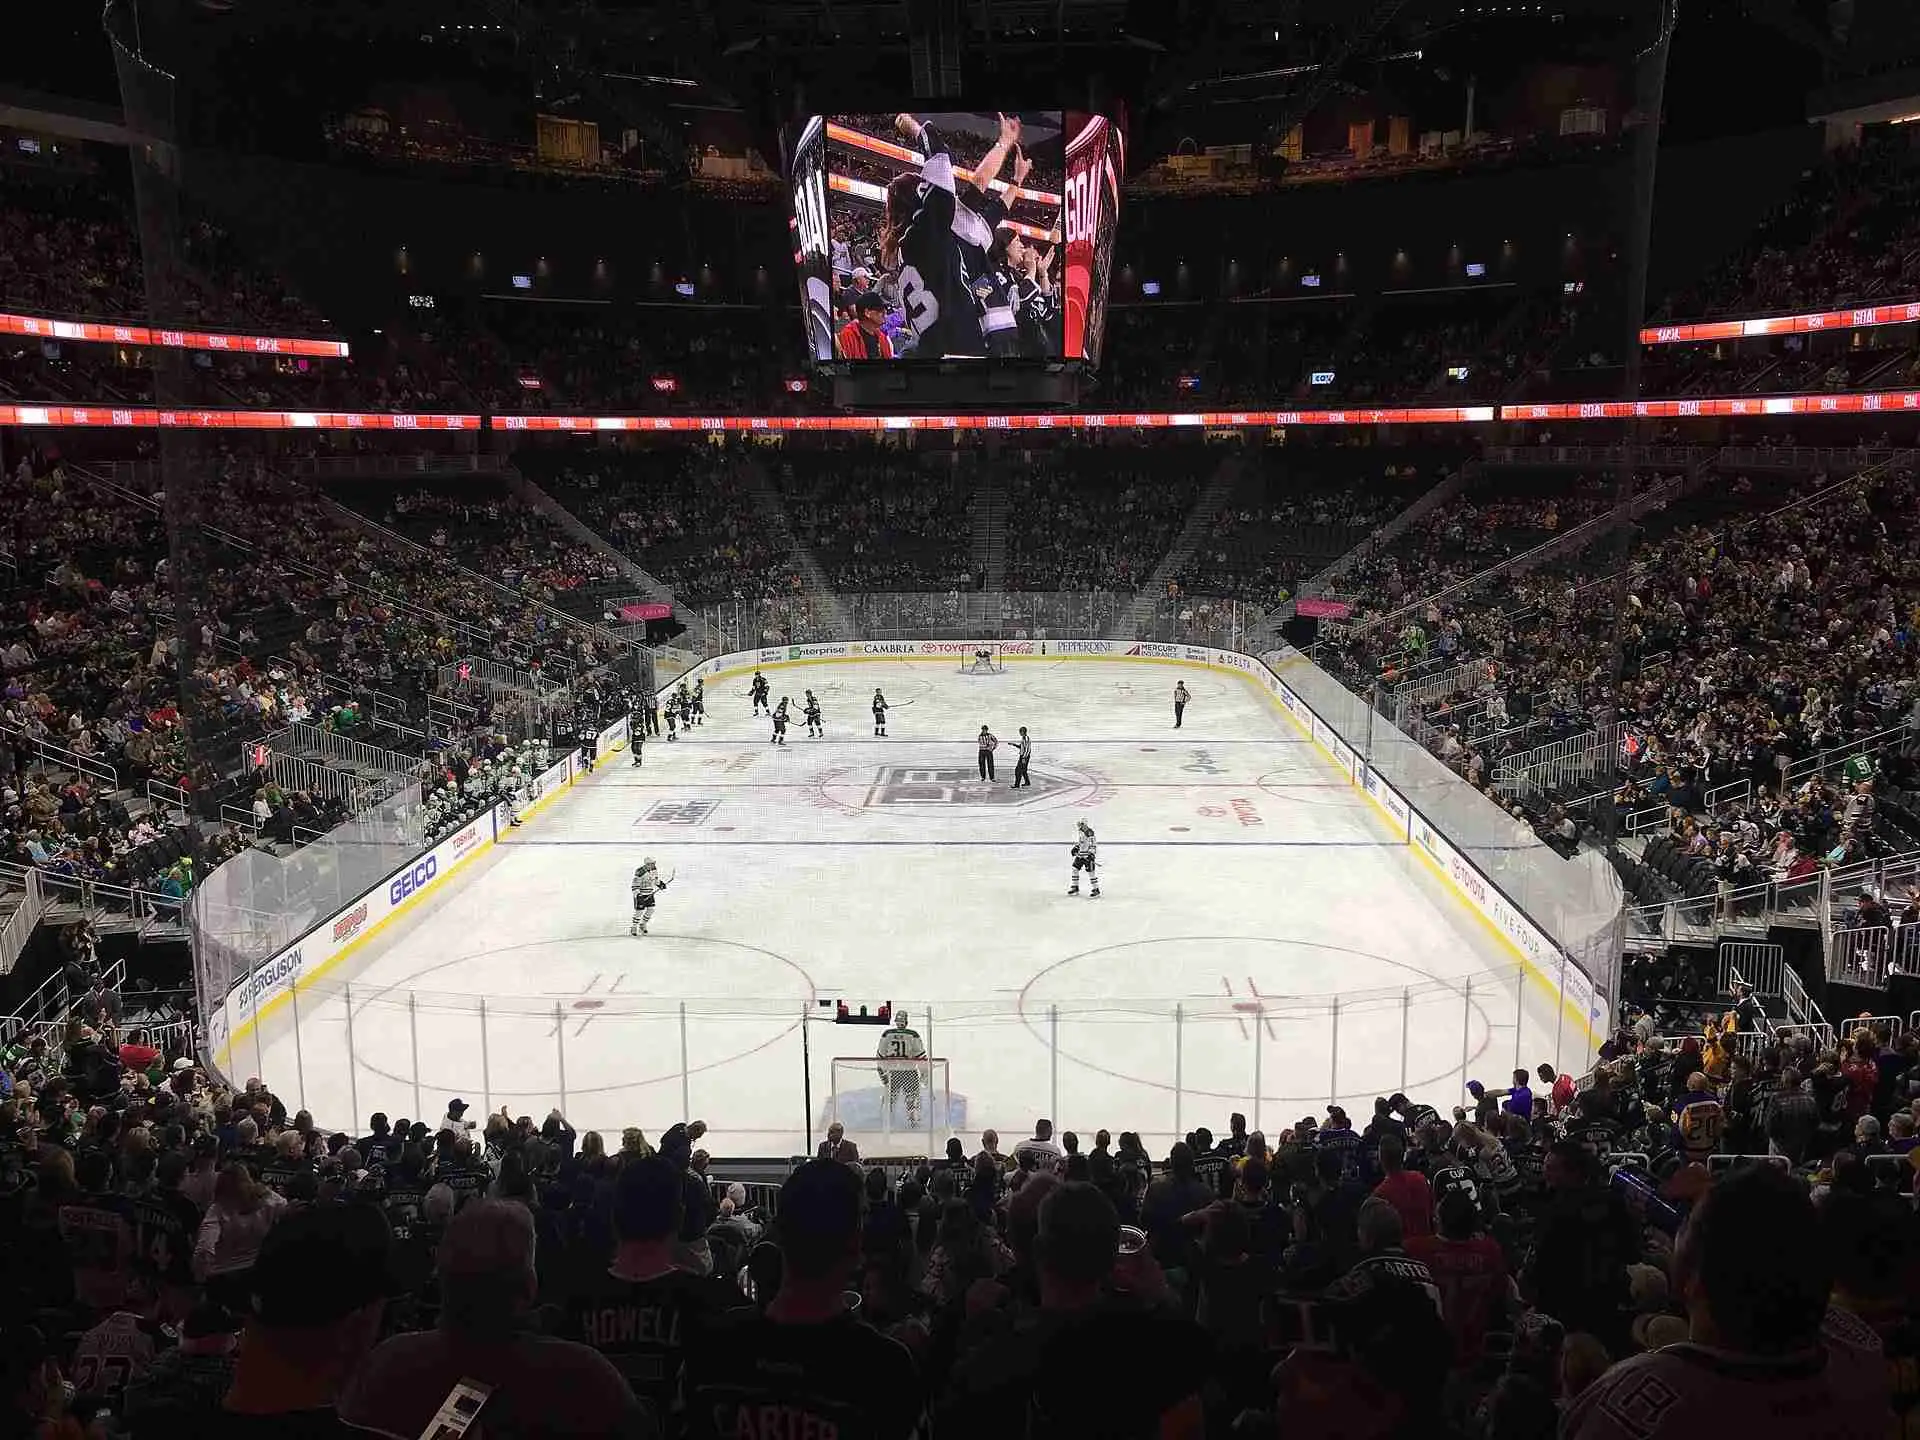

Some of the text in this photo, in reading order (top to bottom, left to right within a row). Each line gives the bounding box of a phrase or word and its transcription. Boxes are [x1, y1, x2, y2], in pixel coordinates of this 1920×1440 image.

[1580, 402, 1605, 417] GOAL
[1678, 401, 1701, 416] GOAL
[393, 415, 416, 428] GOAL
[506, 417, 528, 430] GOAL
[986, 417, 1010, 428] GOAL
[1084, 415, 1105, 427] GOAL
[1277, 412, 1300, 424] GOAL
[864, 641, 914, 655] CAMBRIA
[1141, 644, 1176, 652] MERCURY
[1227, 655, 1250, 669] DELTA
[390, 855, 437, 907] GEICO
[1461, 867, 1484, 905] TOYOTA
[248, 949, 302, 1000] FERGUSON
[892, 1041, 905, 1057] 31
[583, 1304, 682, 1347] HOWELL
[712, 1401, 839, 1440] CARTER
